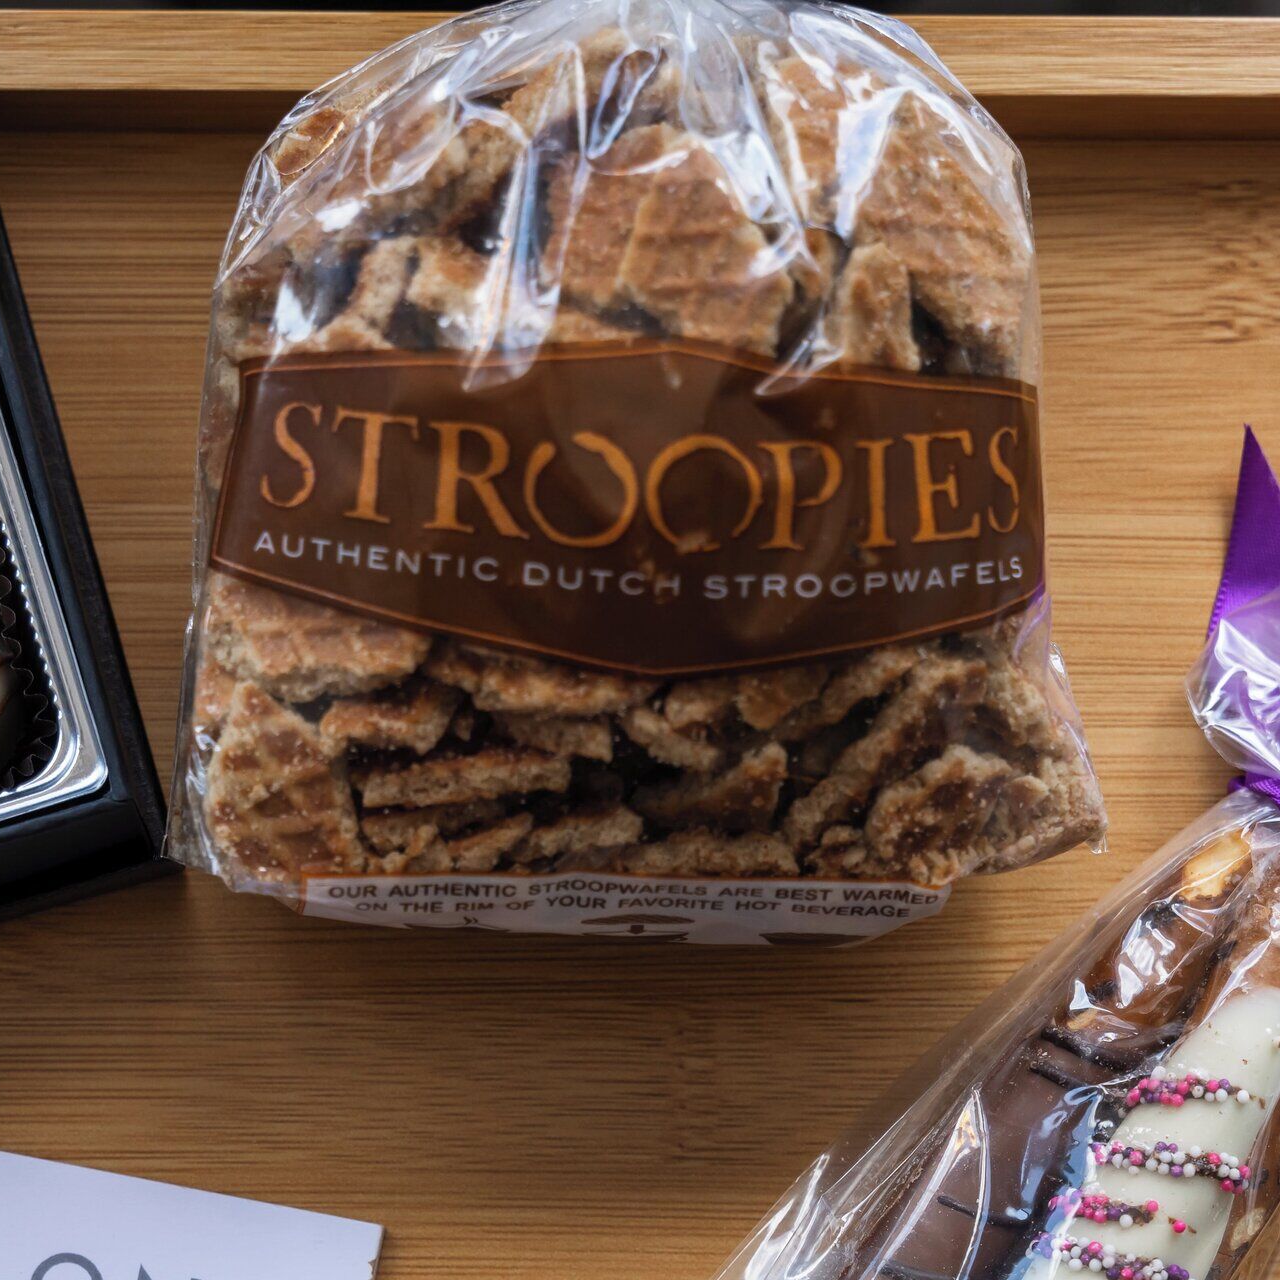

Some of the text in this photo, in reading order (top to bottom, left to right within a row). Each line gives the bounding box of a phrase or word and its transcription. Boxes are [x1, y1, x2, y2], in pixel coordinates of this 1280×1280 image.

[259, 401, 1020, 551] STROOPIES
[254, 531, 1023, 600] AUTHENTIC DUTCH STROOPWAFELS
[328, 879, 939, 905] OUR AUTHENTIC STROOPWAFELS ARE BEST WARMED
[355, 895, 911, 918] ON THE RIM OF YOUR FAVORITE HOT BEVERAGE
